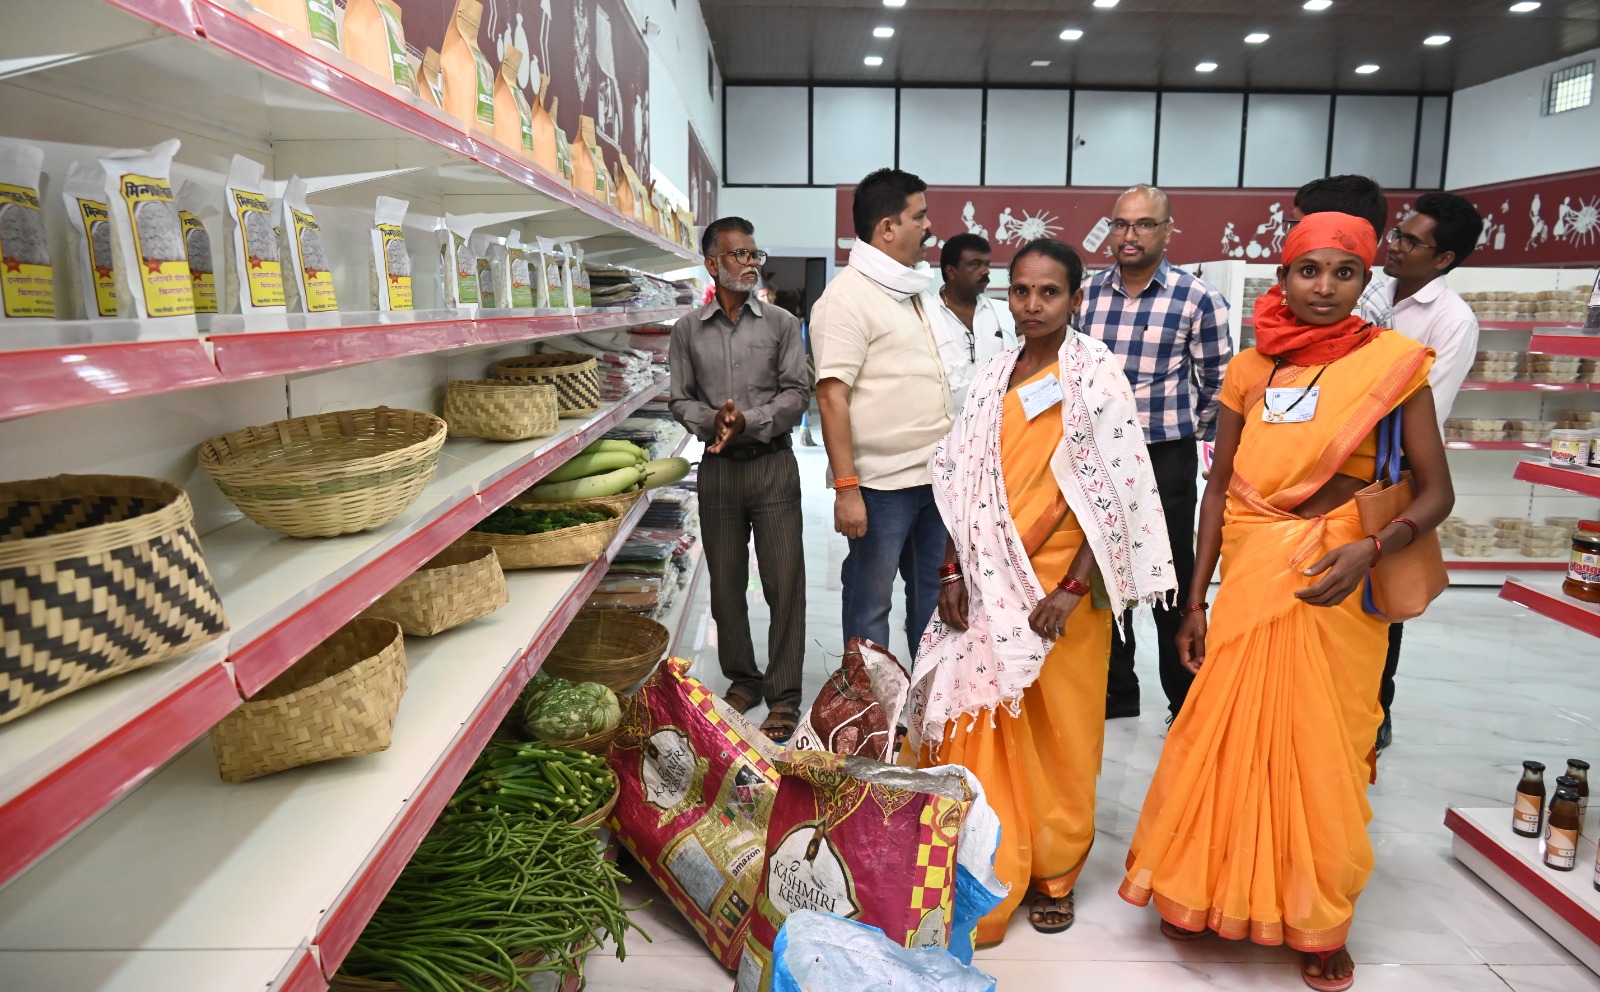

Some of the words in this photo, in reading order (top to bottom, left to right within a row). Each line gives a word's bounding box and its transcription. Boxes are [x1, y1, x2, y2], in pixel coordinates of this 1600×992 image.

[725, 707, 750, 730] KESAR
[796, 735, 813, 751] S
[732, 848, 761, 877] amazon
[773, 860, 837, 912] KASHMIRI
